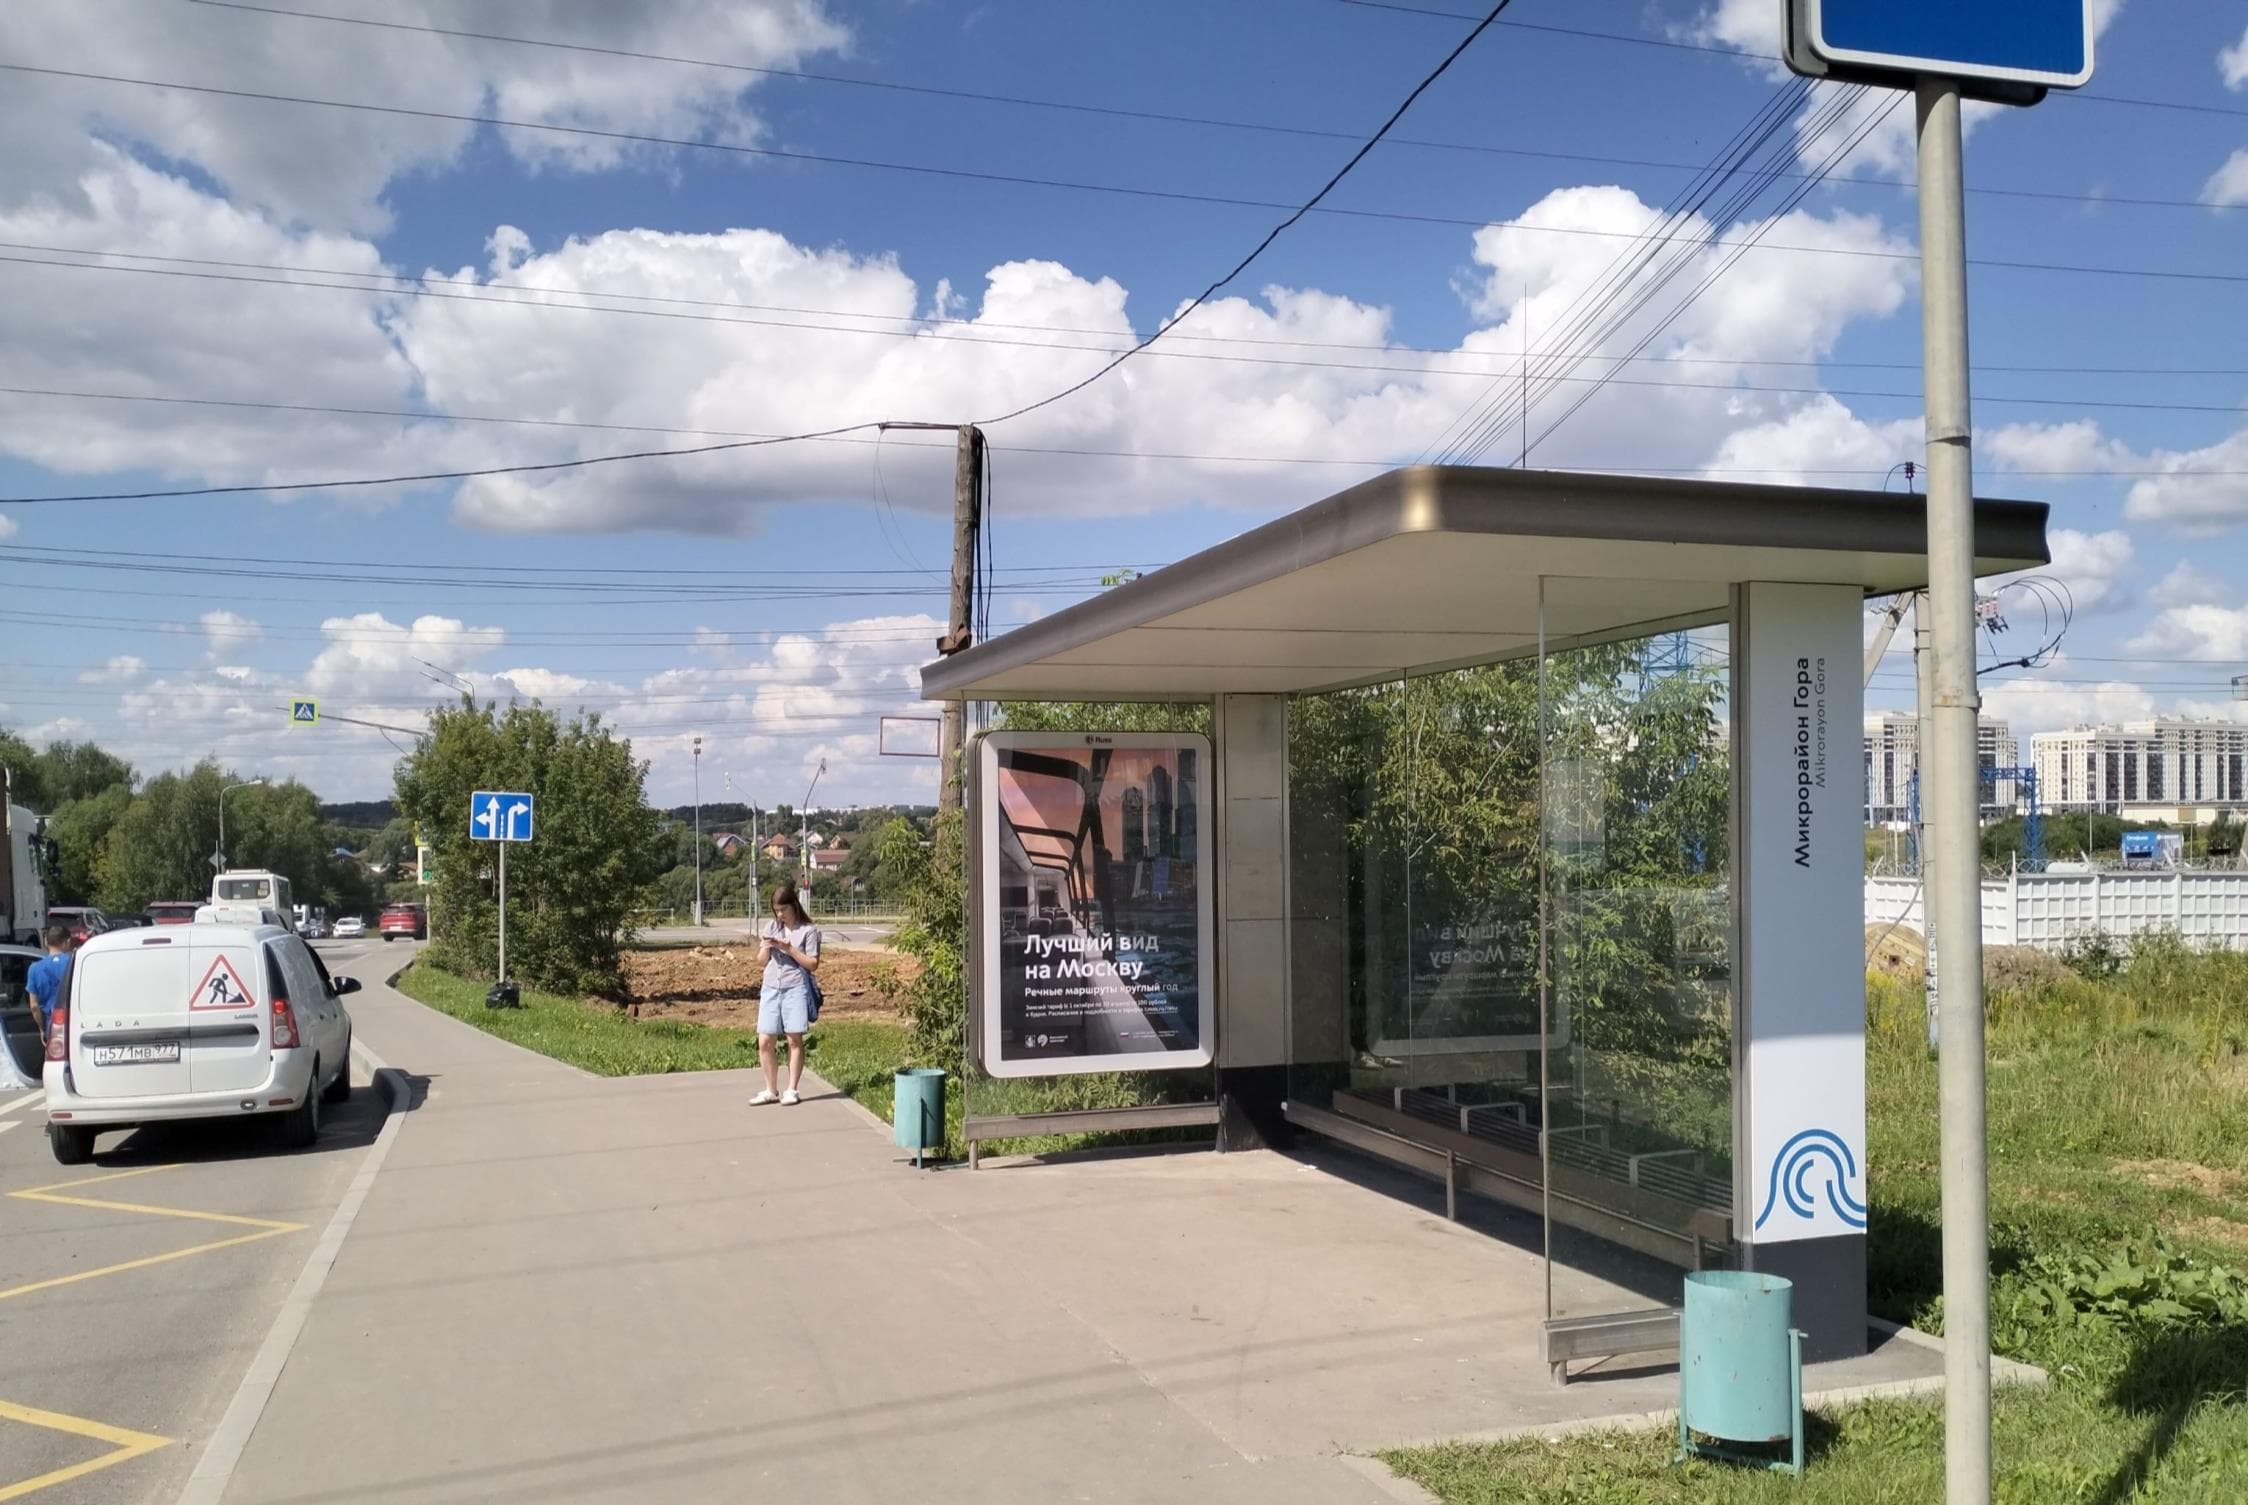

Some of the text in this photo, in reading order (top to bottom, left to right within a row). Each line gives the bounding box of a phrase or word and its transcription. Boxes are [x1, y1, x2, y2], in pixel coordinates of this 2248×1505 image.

[1815, 657, 1827, 788] Mikrorayon Gora
[1794, 657, 1813, 868] Микрорайон Гора
[1024, 932, 1159, 958] Лучший вид
[1025, 958, 1144, 980] на Москву
[1025, 983, 1179, 997] Речные маршруты круглый год
[81, 1020, 140, 1029] LADA
